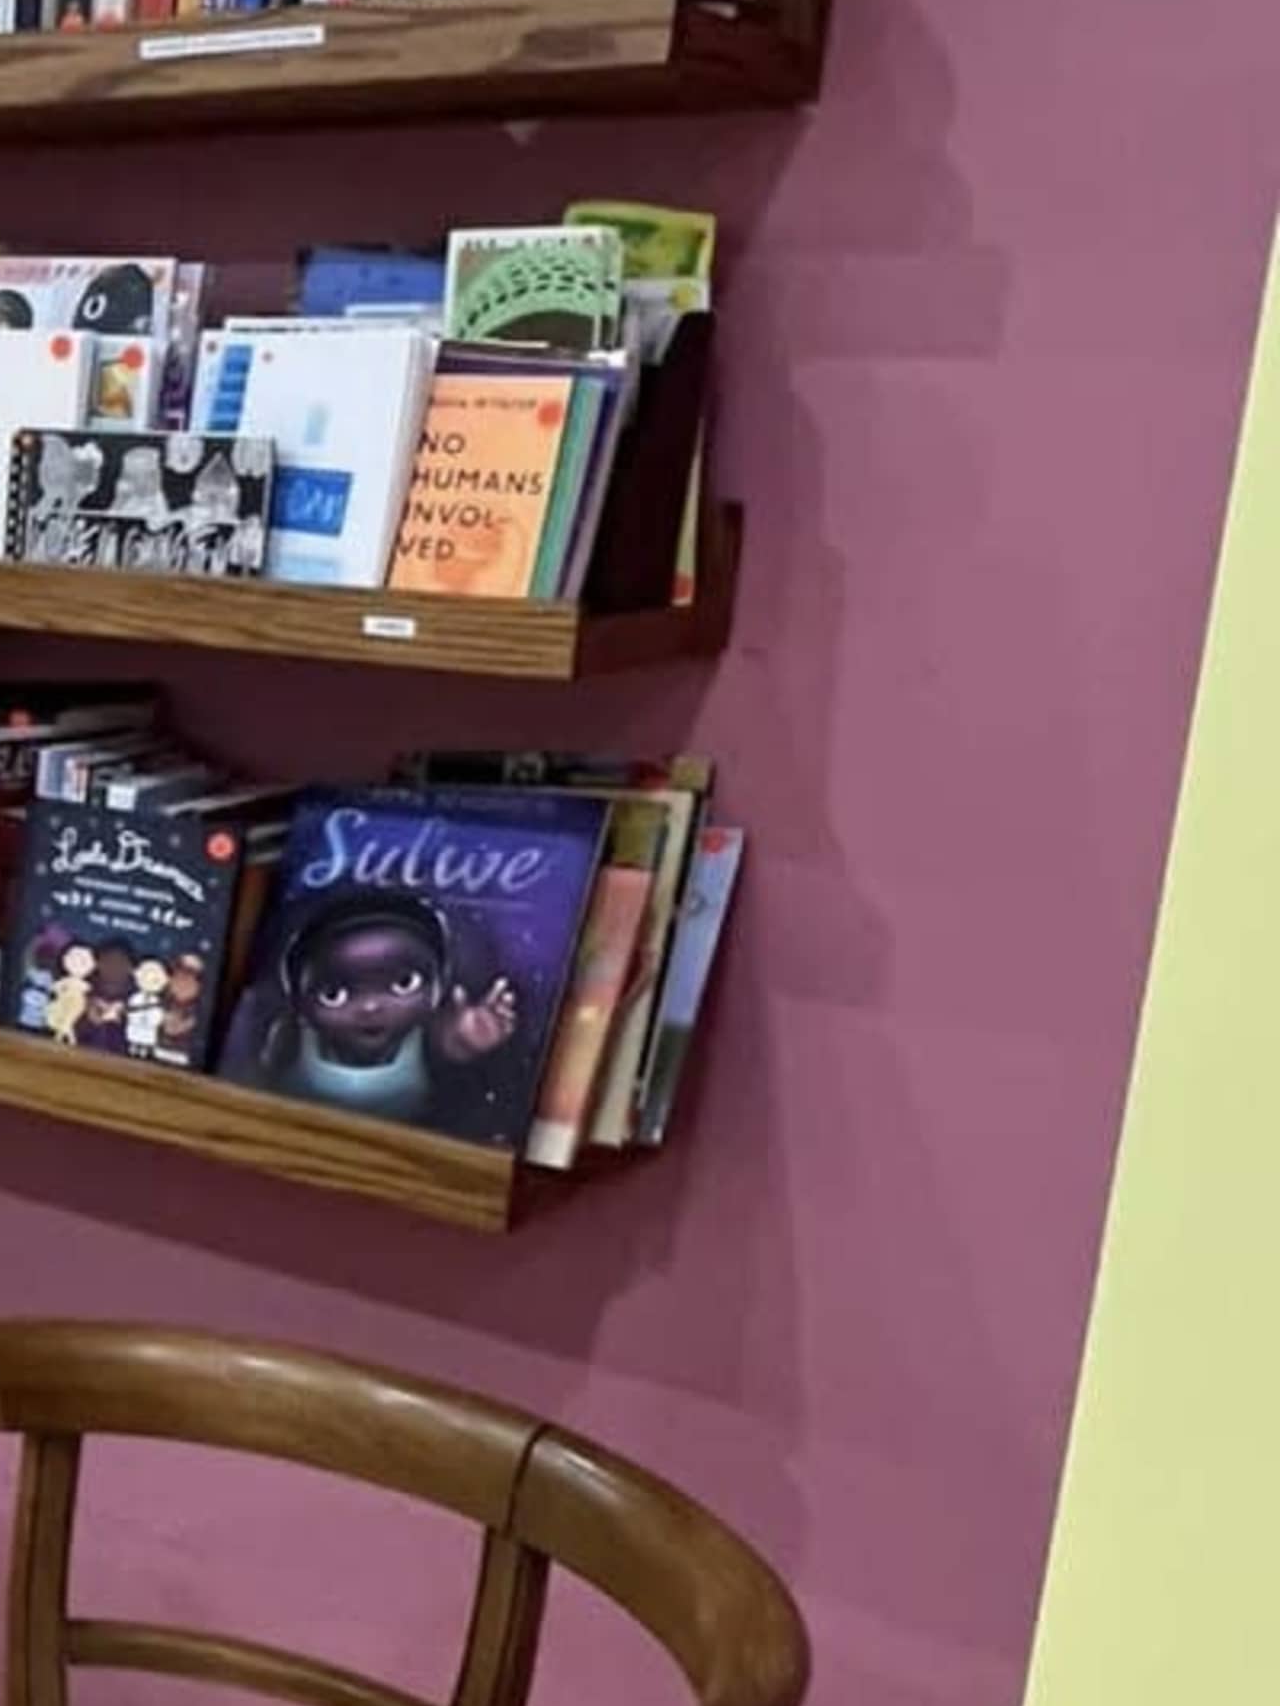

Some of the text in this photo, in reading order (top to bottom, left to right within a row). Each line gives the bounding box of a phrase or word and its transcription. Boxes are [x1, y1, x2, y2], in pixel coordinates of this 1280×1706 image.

[418, 429, 467, 456] NO
[411, 465, 545, 495] HUMANS
[397, 534, 456, 562] VED
[301, 807, 544, 892] Sulwe
